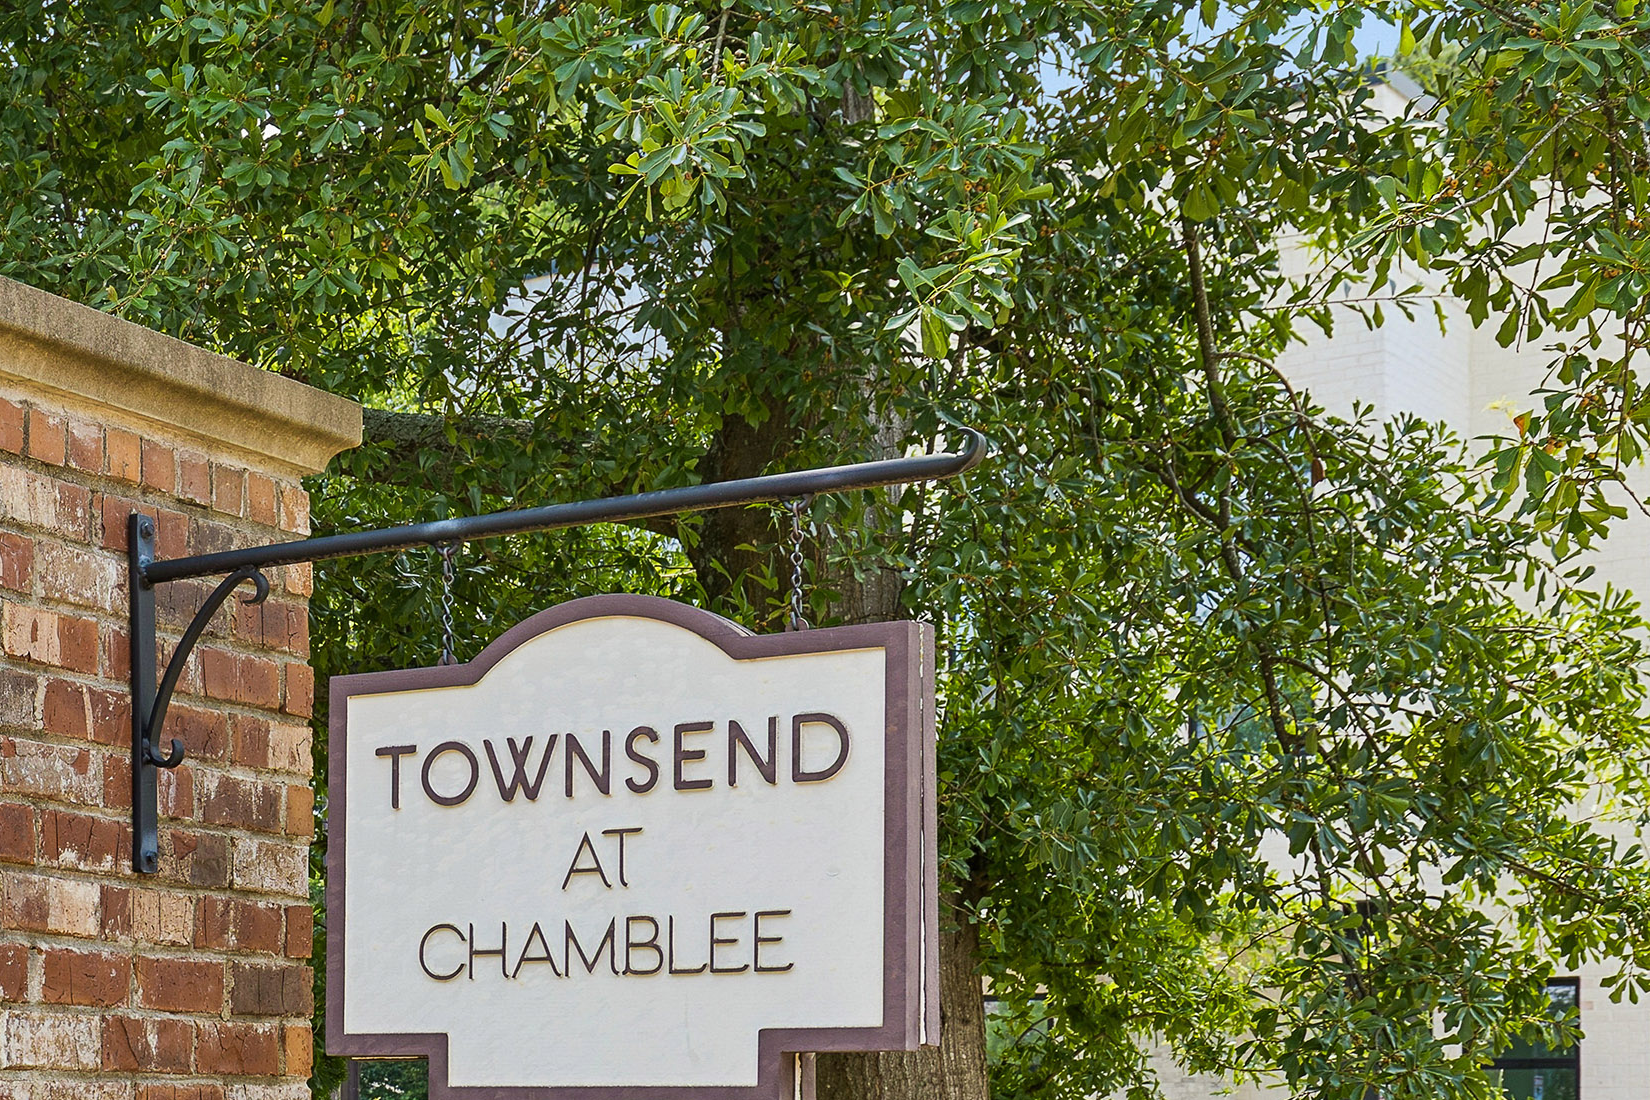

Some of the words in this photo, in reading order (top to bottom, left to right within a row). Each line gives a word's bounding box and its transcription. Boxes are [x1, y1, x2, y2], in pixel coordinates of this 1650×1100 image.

[374, 712, 851, 811] TOWNSEND
[561, 827, 643, 891] AT
[418, 909, 795, 981] CHAMBLEE
